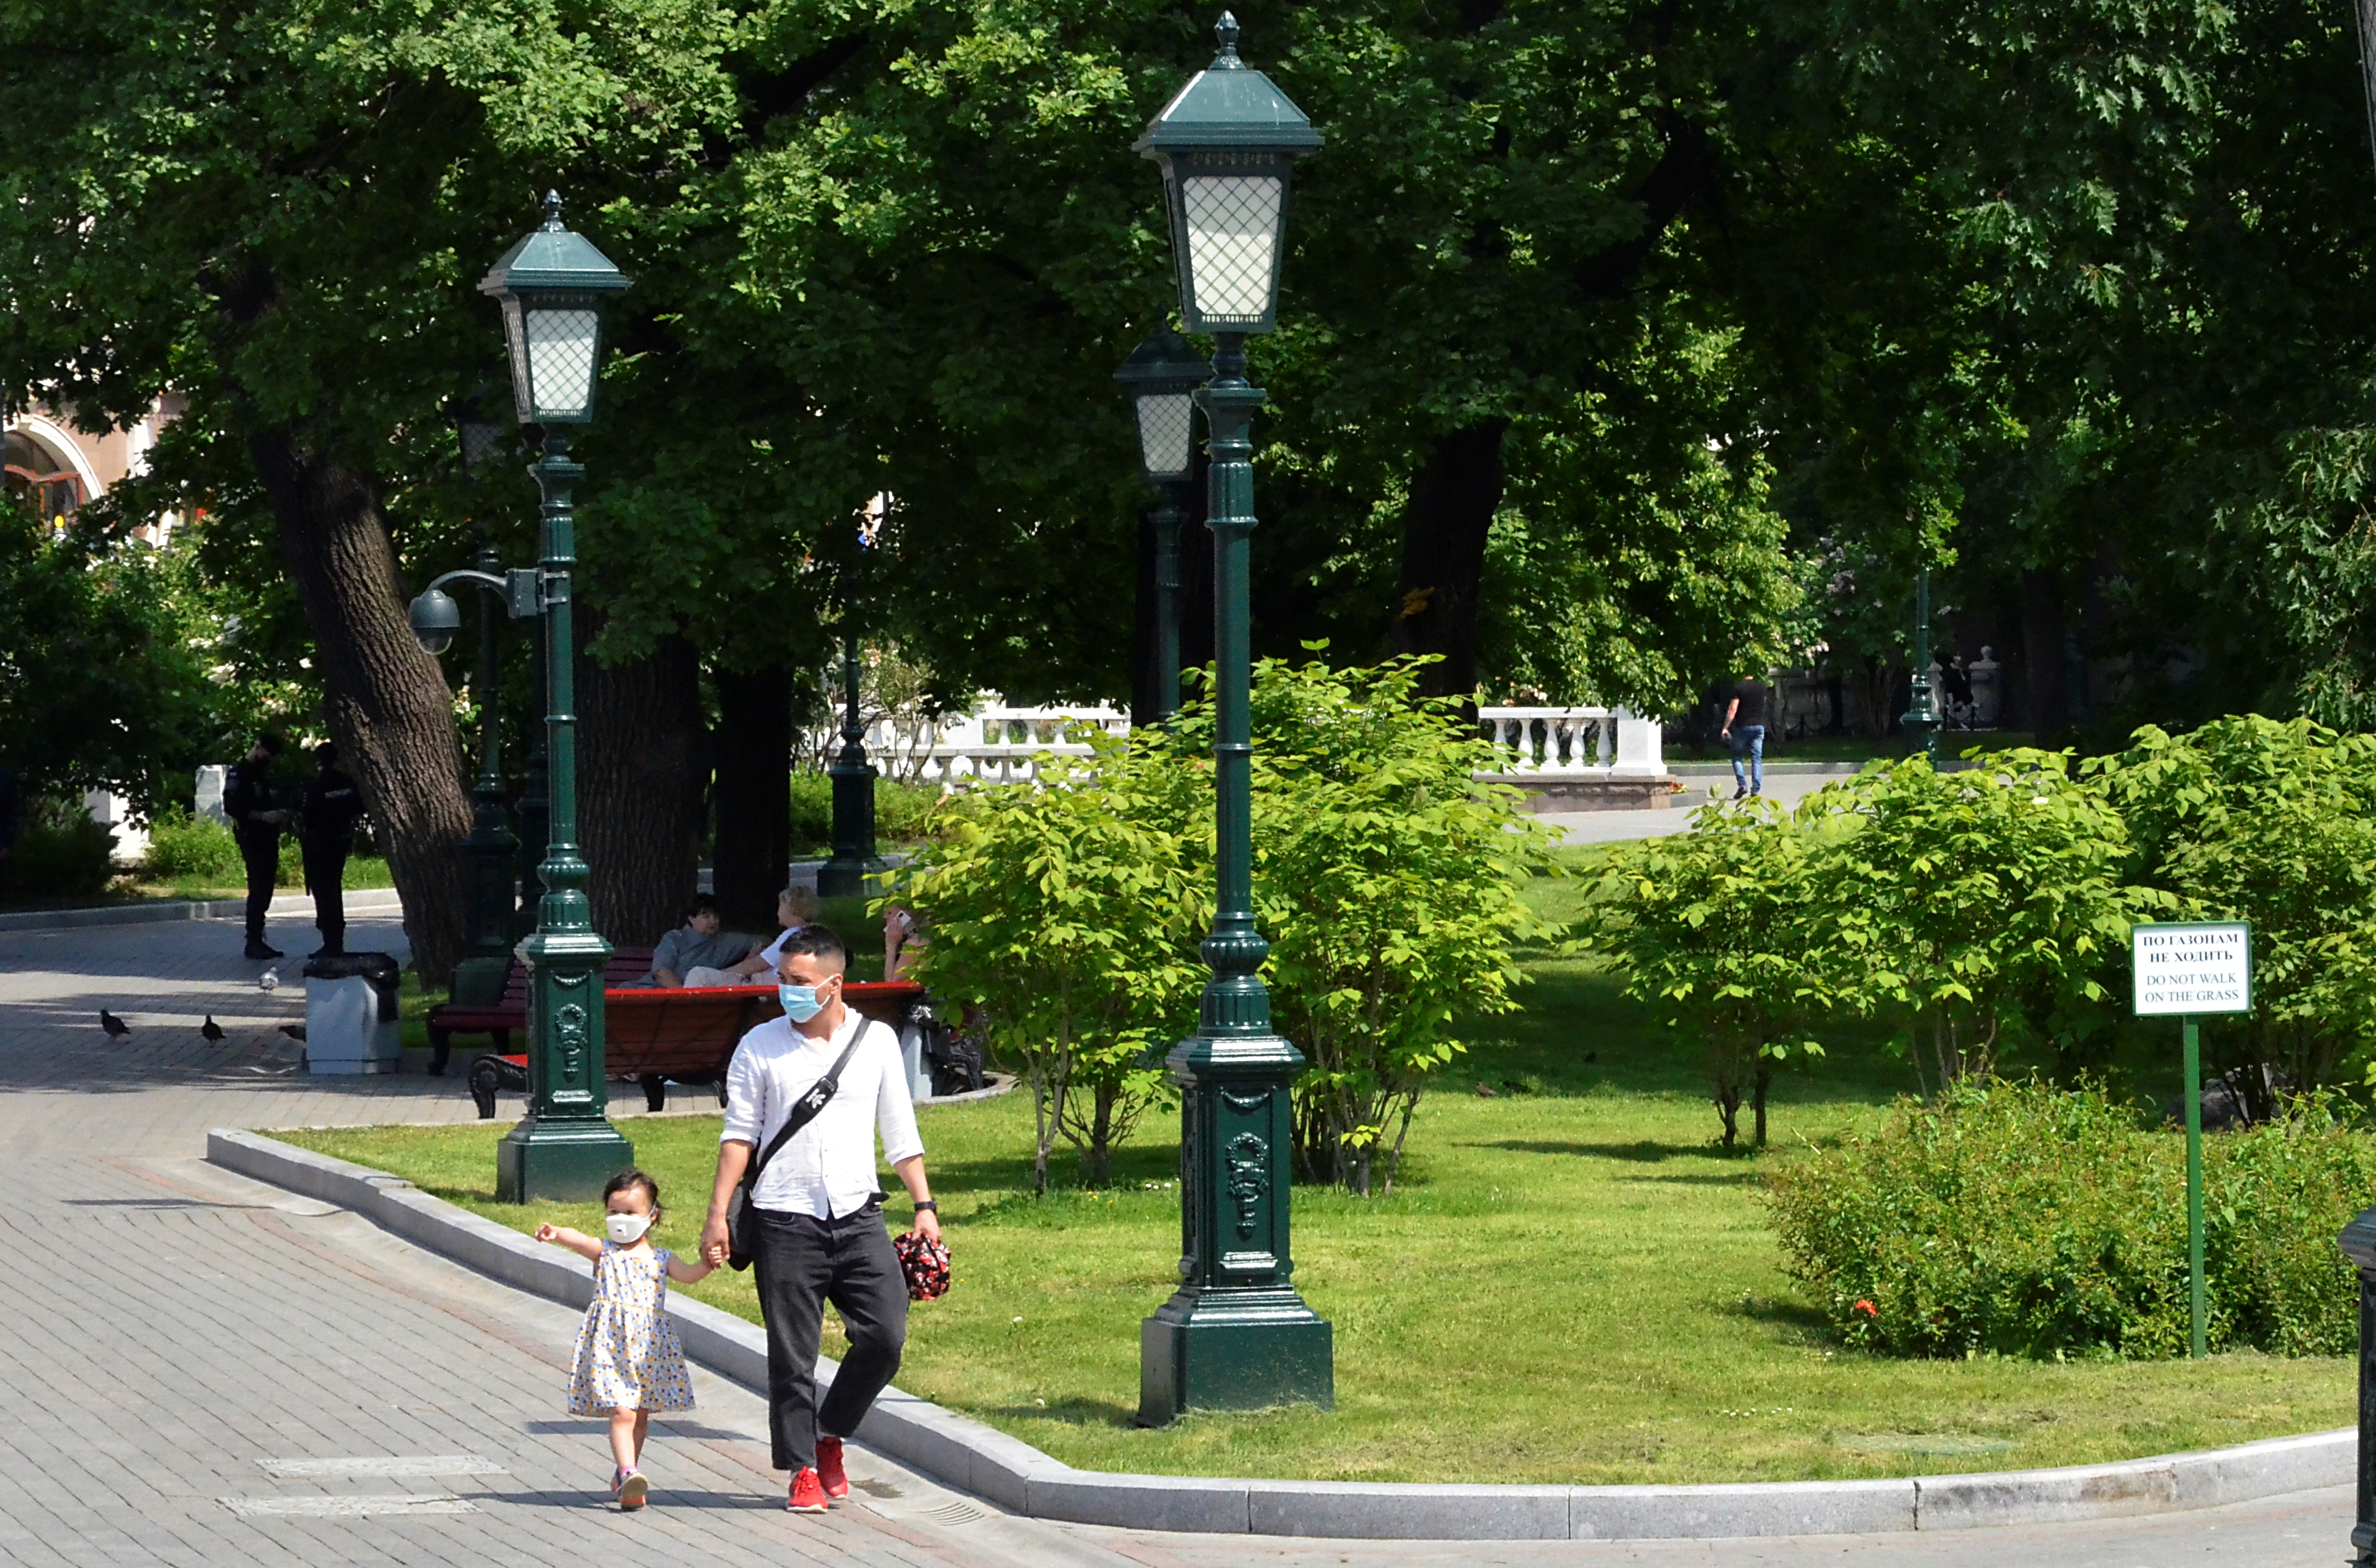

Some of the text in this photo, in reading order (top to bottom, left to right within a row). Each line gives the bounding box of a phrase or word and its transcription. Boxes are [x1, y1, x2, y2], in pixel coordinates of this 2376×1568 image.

[2143, 934, 2239, 946] ПО ГАЗОНАМ
[2150, 950, 2233, 963] НЕ ХОДИТЬ
[2147, 973, 2237, 986] DO NOT WALK
[2145, 990, 2239, 1003] ON THE GRASS
